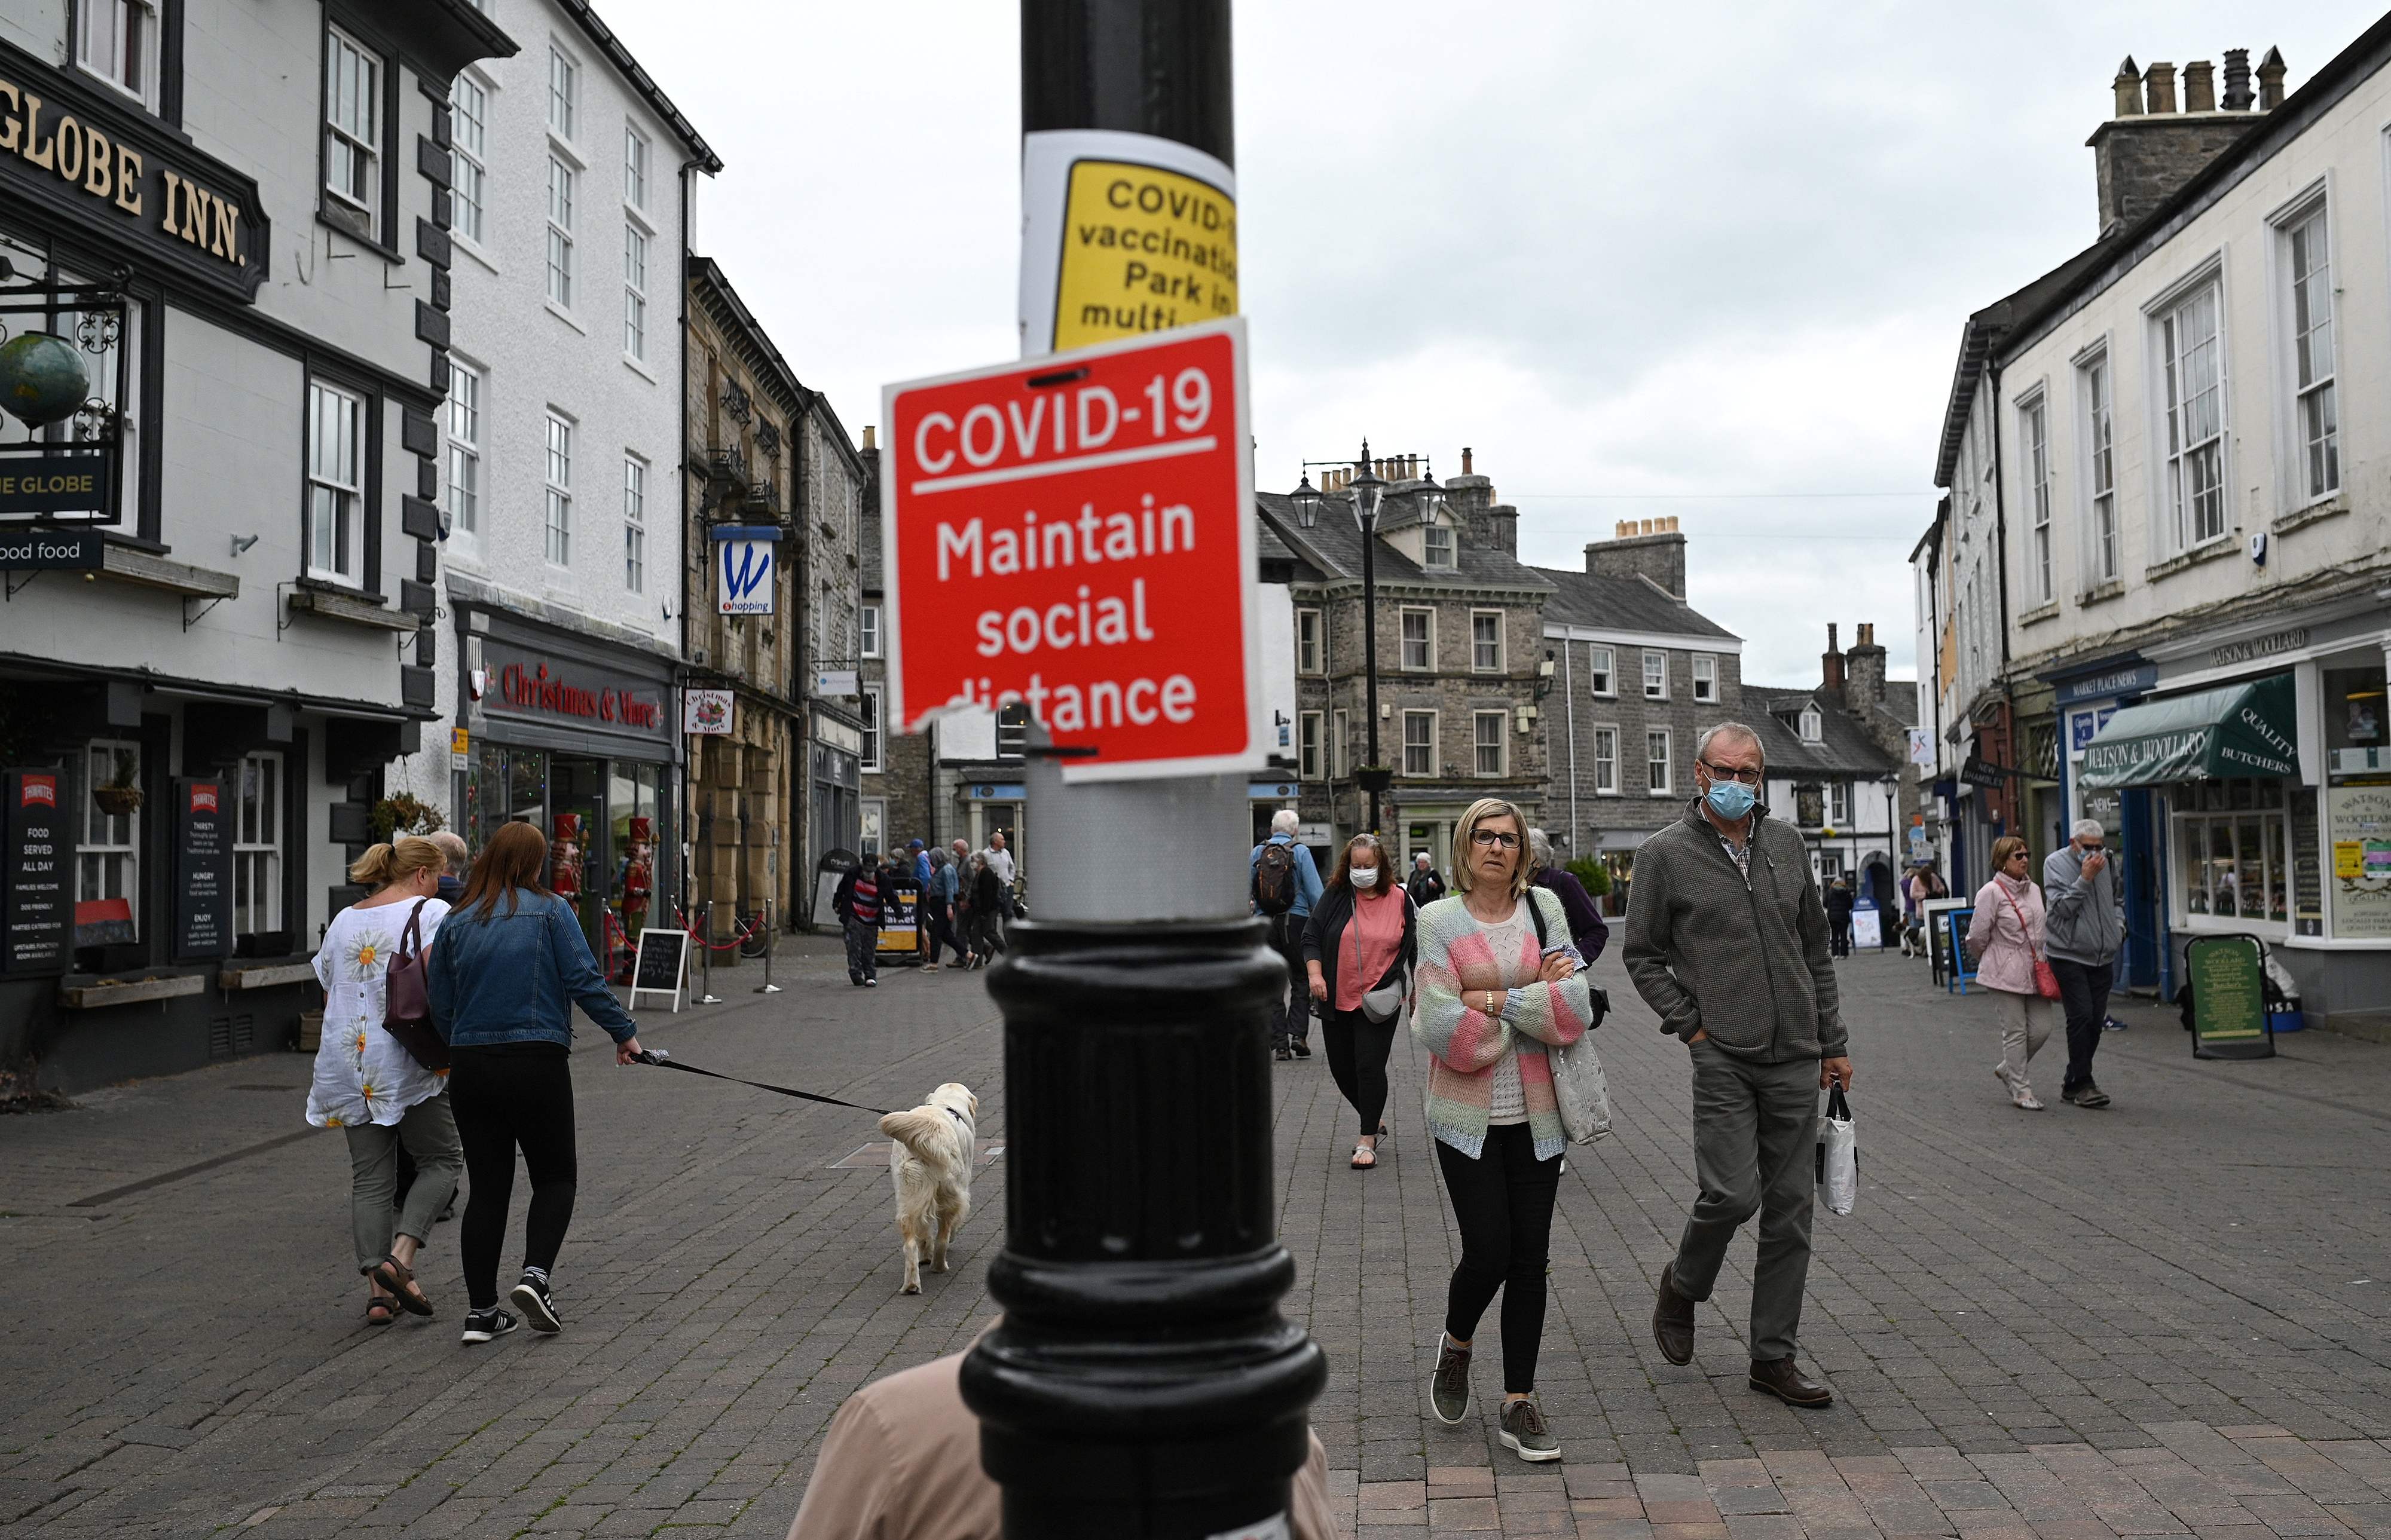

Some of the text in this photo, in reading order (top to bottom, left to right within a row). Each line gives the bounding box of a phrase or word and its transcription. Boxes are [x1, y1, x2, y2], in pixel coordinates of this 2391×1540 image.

[0, 79, 245, 268] GLOBE INN.
[1124, 260, 1201, 305] Park
[915, 367, 1212, 475] COVID-19
[22, 475, 93, 494] GLOBE
[936, 492, 1196, 582] Maintain
[38, 541, 80, 560] food
[724, 540, 769, 601] W
[977, 577, 1154, 659] social
[504, 661, 597, 718] Christmas
[601, 685, 615, 721] &
[2073, 669, 2137, 697] MARKET PLACE NEWS
[687, 693, 731, 708] Christmas
[703, 721, 725, 732] More
[2240, 708, 2296, 758] QUALITY
[2088, 731, 2206, 769] WATSON & WOOLLARD
[2221, 746, 2292, 774] BUTCHERS
[2094, 796, 2112, 813] NEWS
[27, 828, 49, 838] FOOD
[193, 822, 215, 831] THIRSTY
[23, 844, 53, 855] SERVED
[22, 861, 54, 872] ALL DAY
[192, 871, 214, 880] HUNGRY
[194, 913, 212, 922] ENJOY
